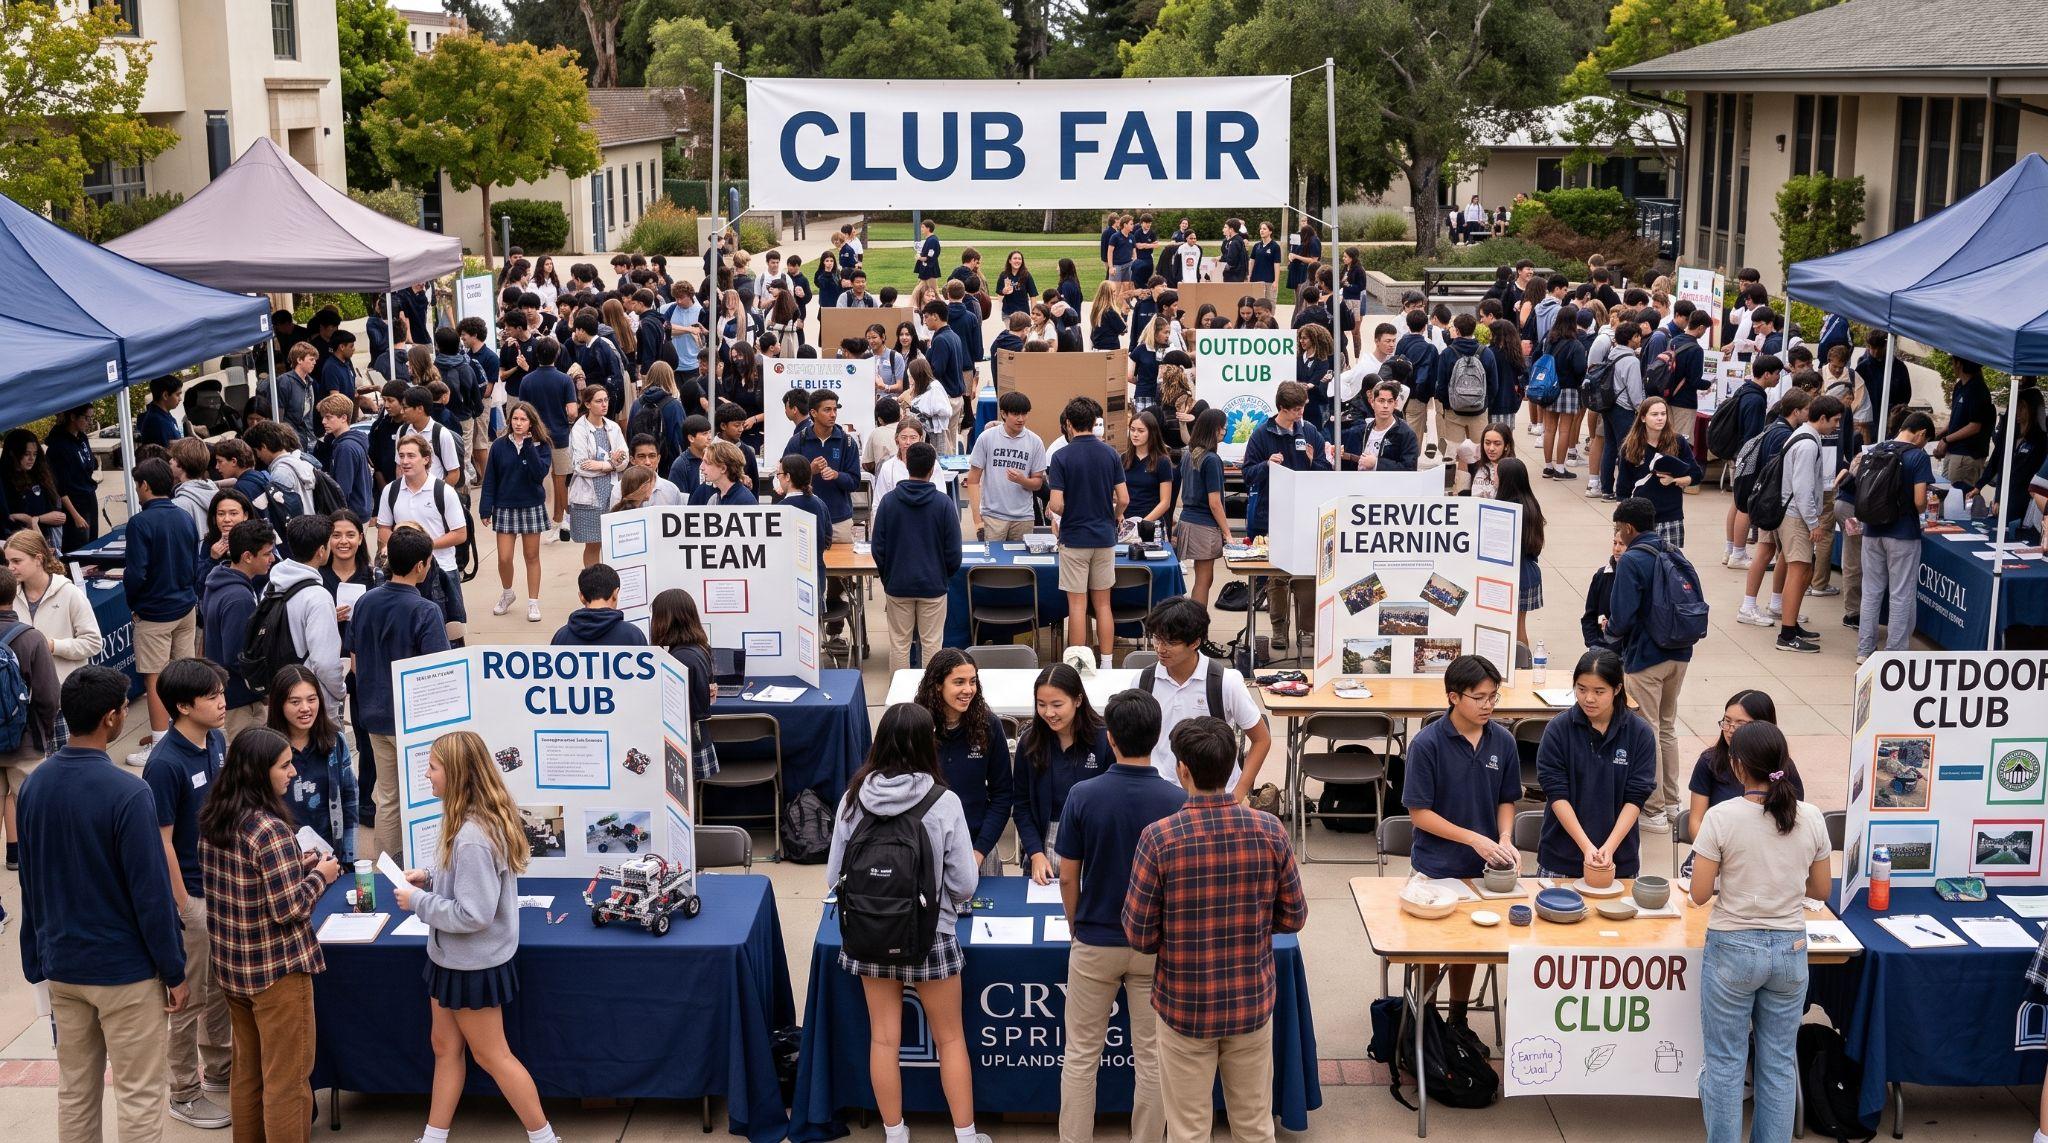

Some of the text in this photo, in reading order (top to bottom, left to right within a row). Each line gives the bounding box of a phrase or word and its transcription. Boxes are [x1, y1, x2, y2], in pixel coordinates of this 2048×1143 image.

[779, 110, 1260, 182] CLUB FAIR
[1199, 337, 1294, 356] OUTDOOR
[1221, 364, 1272, 383] CLUB
[661, 512, 783, 538] DEBATE
[1350, 503, 1459, 526] SERVICE
[1340, 531, 1470, 554] LEARNING
[678, 543, 766, 570] TEAM
[1918, 563, 1967, 612] CRYSTAL
[482, 651, 656, 680] ROBOTICS
[524, 685, 616, 715] CLUB
[1913, 696, 2009, 729] CLUB
[1533, 954, 1688, 991] OUTDOOR
[1554, 995, 1651, 1033] CLUB
[981, 1026, 1133, 1047] SPRIG
[981, 1054, 1065, 1067] UPLANDS
